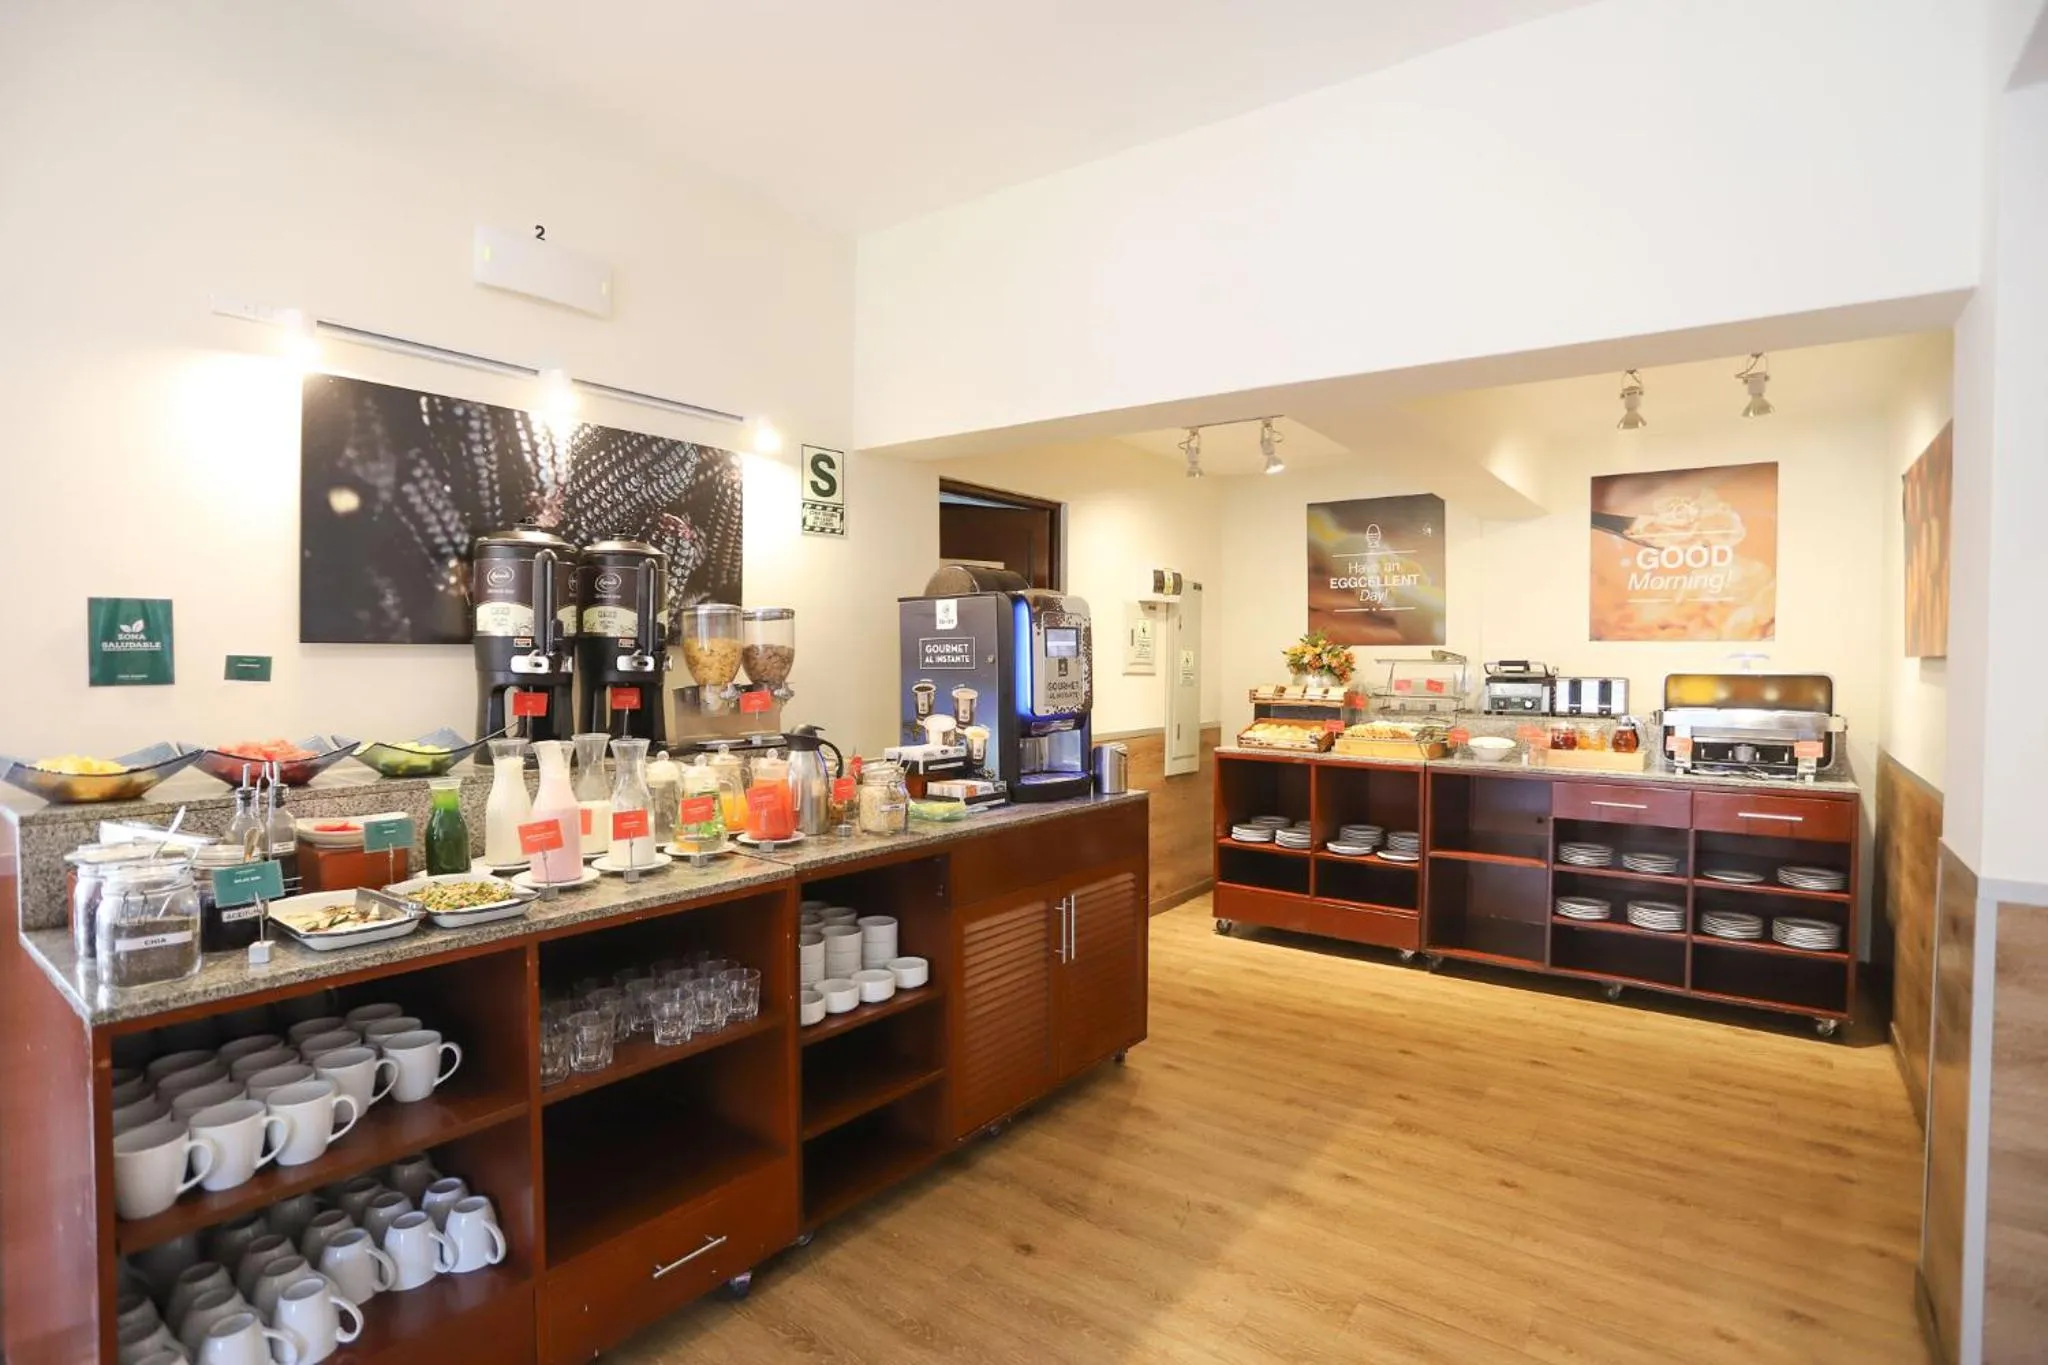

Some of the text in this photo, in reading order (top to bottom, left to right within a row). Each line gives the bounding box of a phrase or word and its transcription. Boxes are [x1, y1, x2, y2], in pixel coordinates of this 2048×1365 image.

[535, 225, 546, 241] 2
[810, 452, 837, 498] S
[1636, 545, 1734, 570] GOOD
[1384, 561, 1401, 573] an
[1329, 574, 1420, 590] EGGCELLENT
[1628, 570, 1732, 594] Morning!
[1359, 588, 1388, 605] Day!
[101, 641, 162, 649] SALUDABLE
[925, 643, 969, 654] GOURMET
[925, 654, 971, 663] AL INSTANTE
[144, 938, 167, 946] CHIA
